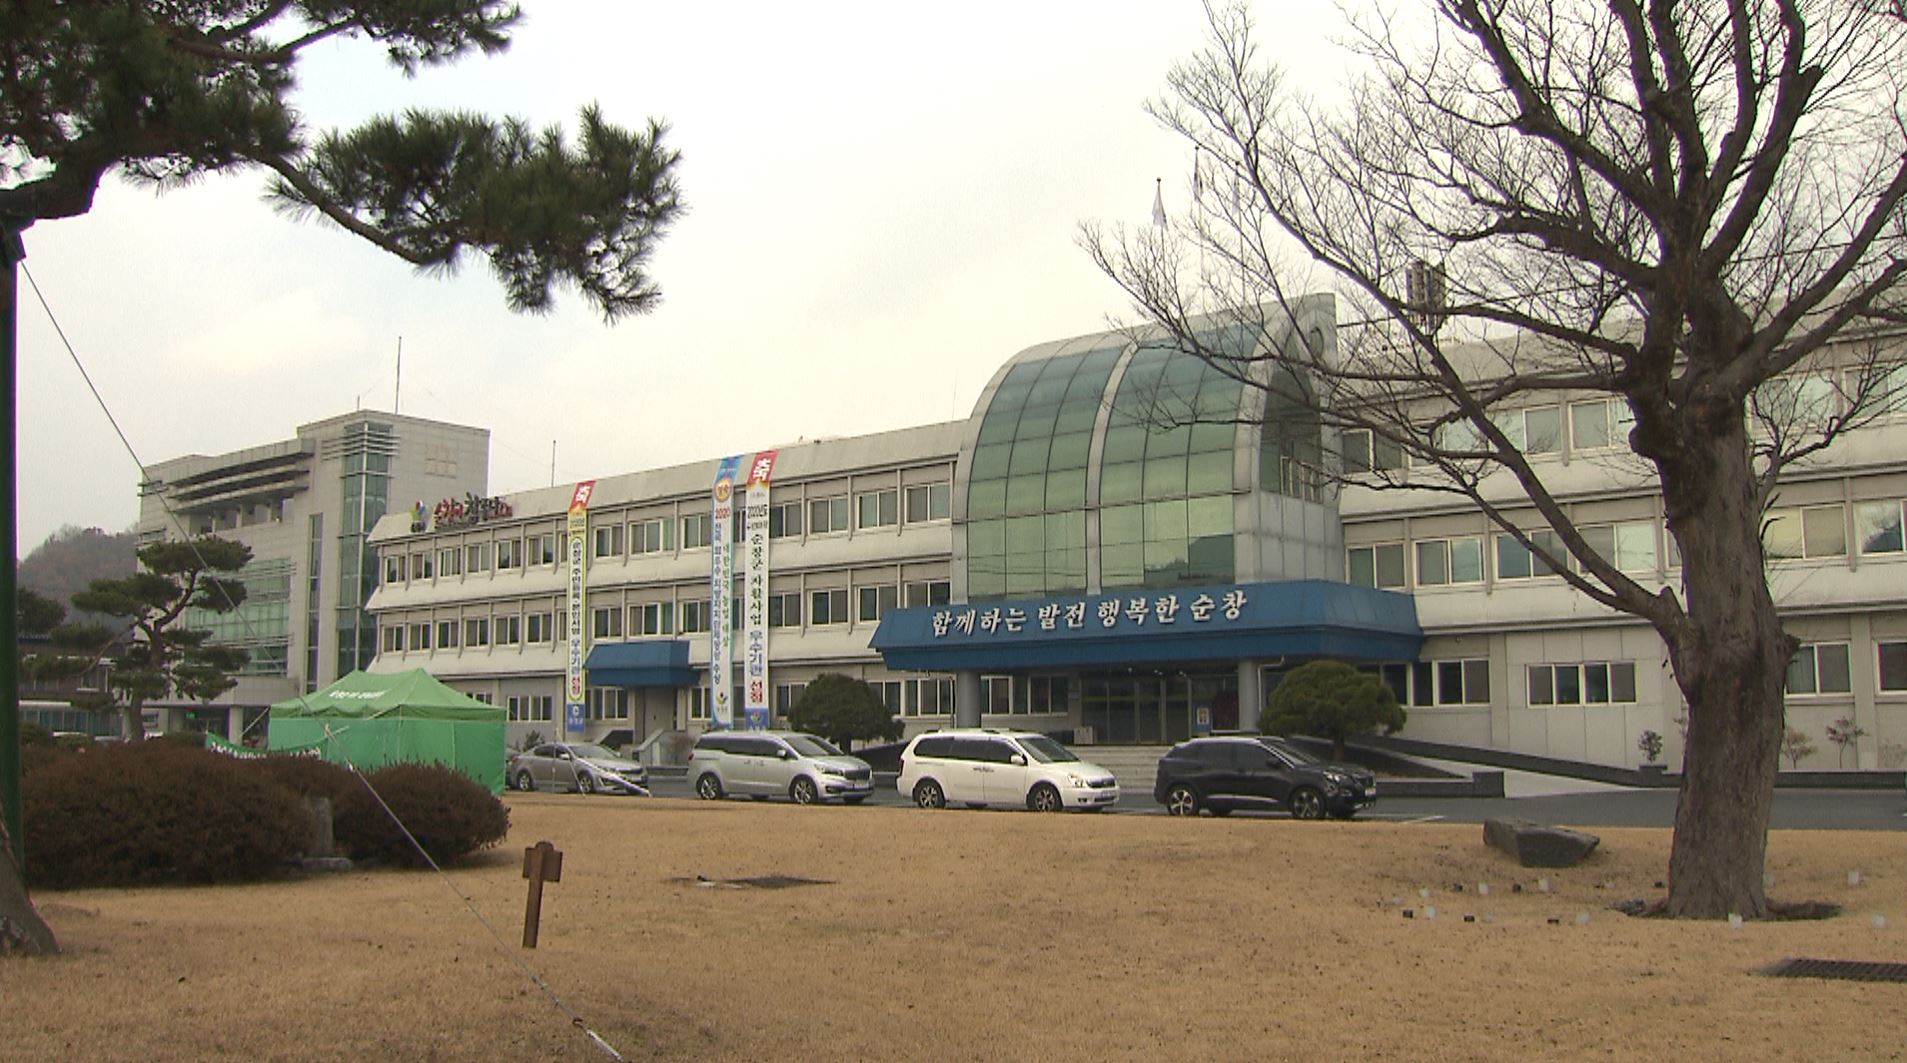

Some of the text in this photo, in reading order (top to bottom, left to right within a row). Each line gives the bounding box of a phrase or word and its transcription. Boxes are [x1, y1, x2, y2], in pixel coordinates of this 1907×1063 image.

[751, 457, 771, 482] 축
[750, 533, 764, 571] 순창군
[931, 589, 1248, 638] 함께하는 발전 행복한 순창
[748, 629, 763, 677] 우수기관
[750, 680, 763, 703] 선정
